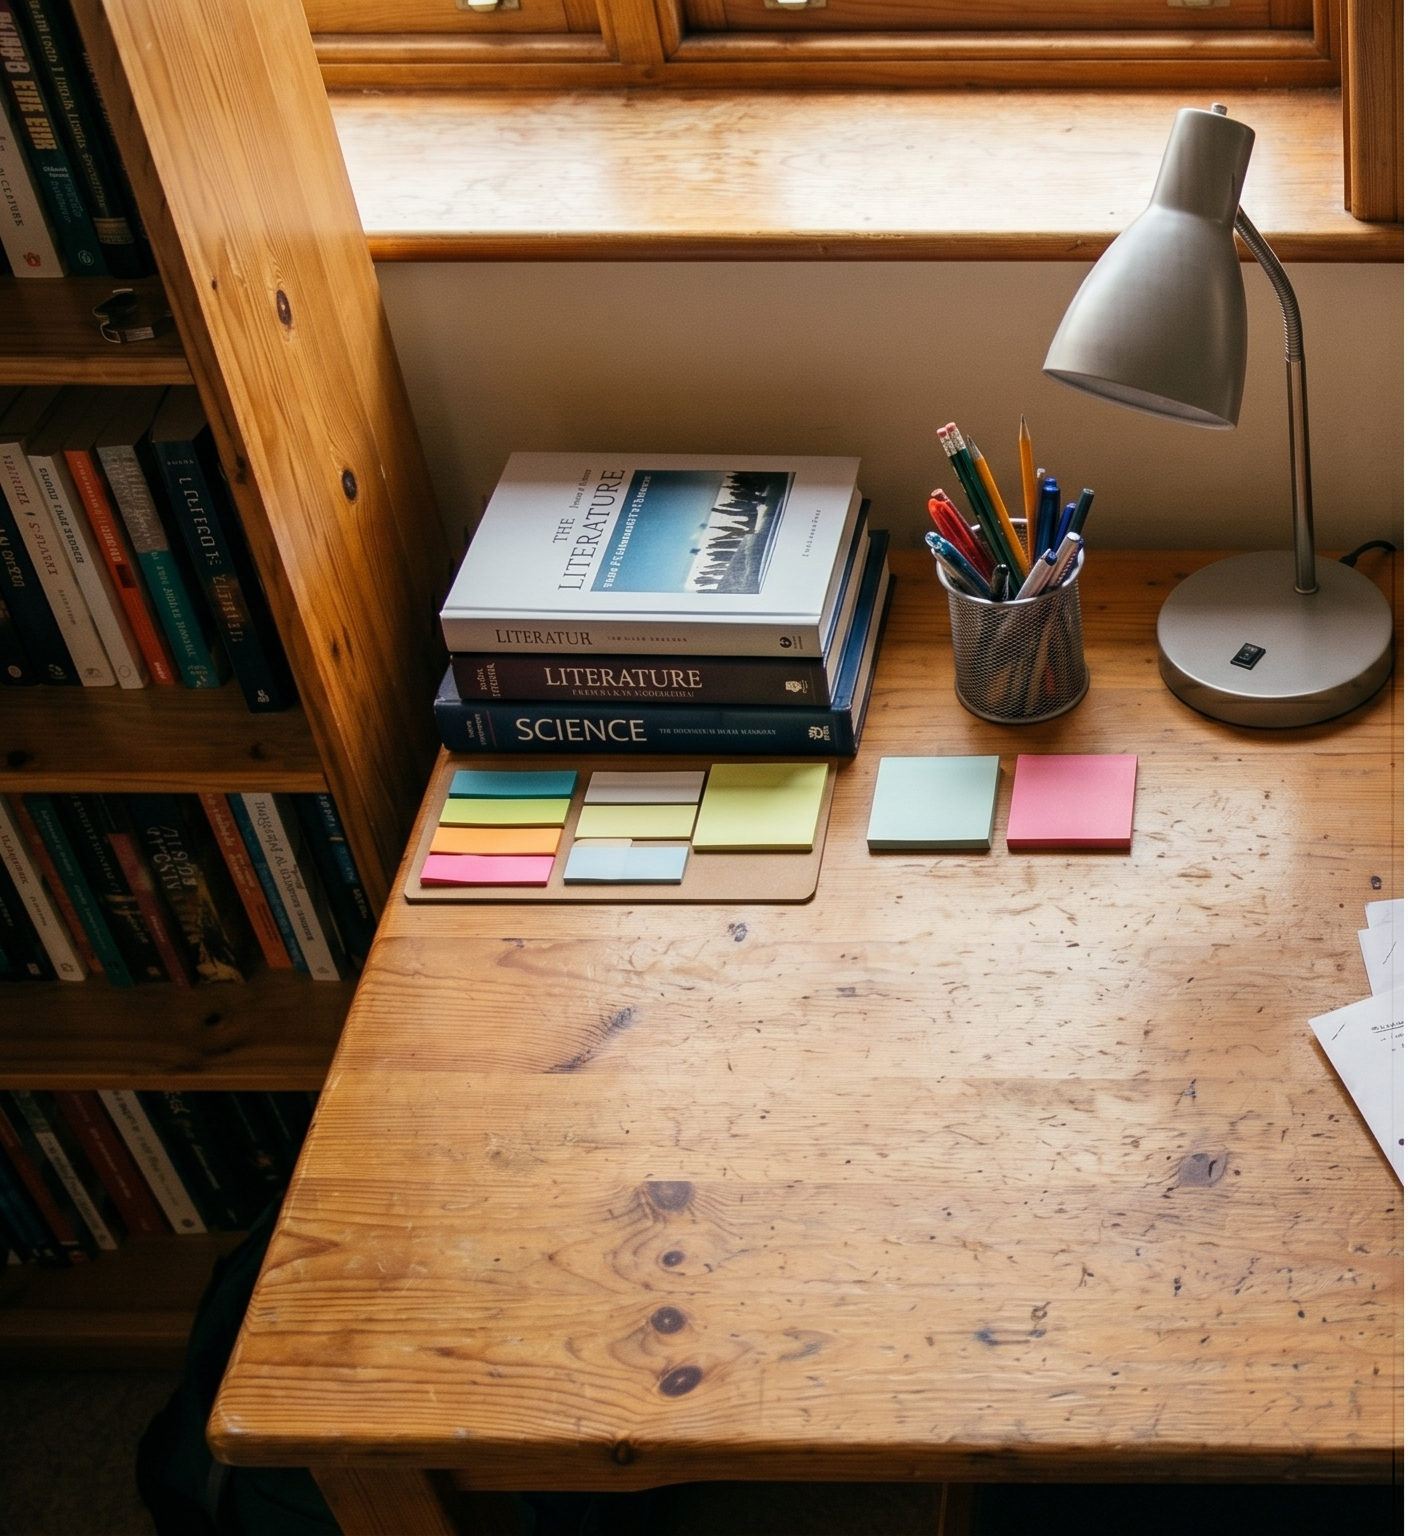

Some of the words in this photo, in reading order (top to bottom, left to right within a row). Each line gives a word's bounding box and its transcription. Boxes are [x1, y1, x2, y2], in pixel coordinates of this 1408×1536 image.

[553, 518, 575, 543] THE
[558, 470, 625, 590] LITERATURE
[544, 667, 703, 688] LITERATURE
[515, 718, 648, 742] SCIENCE
